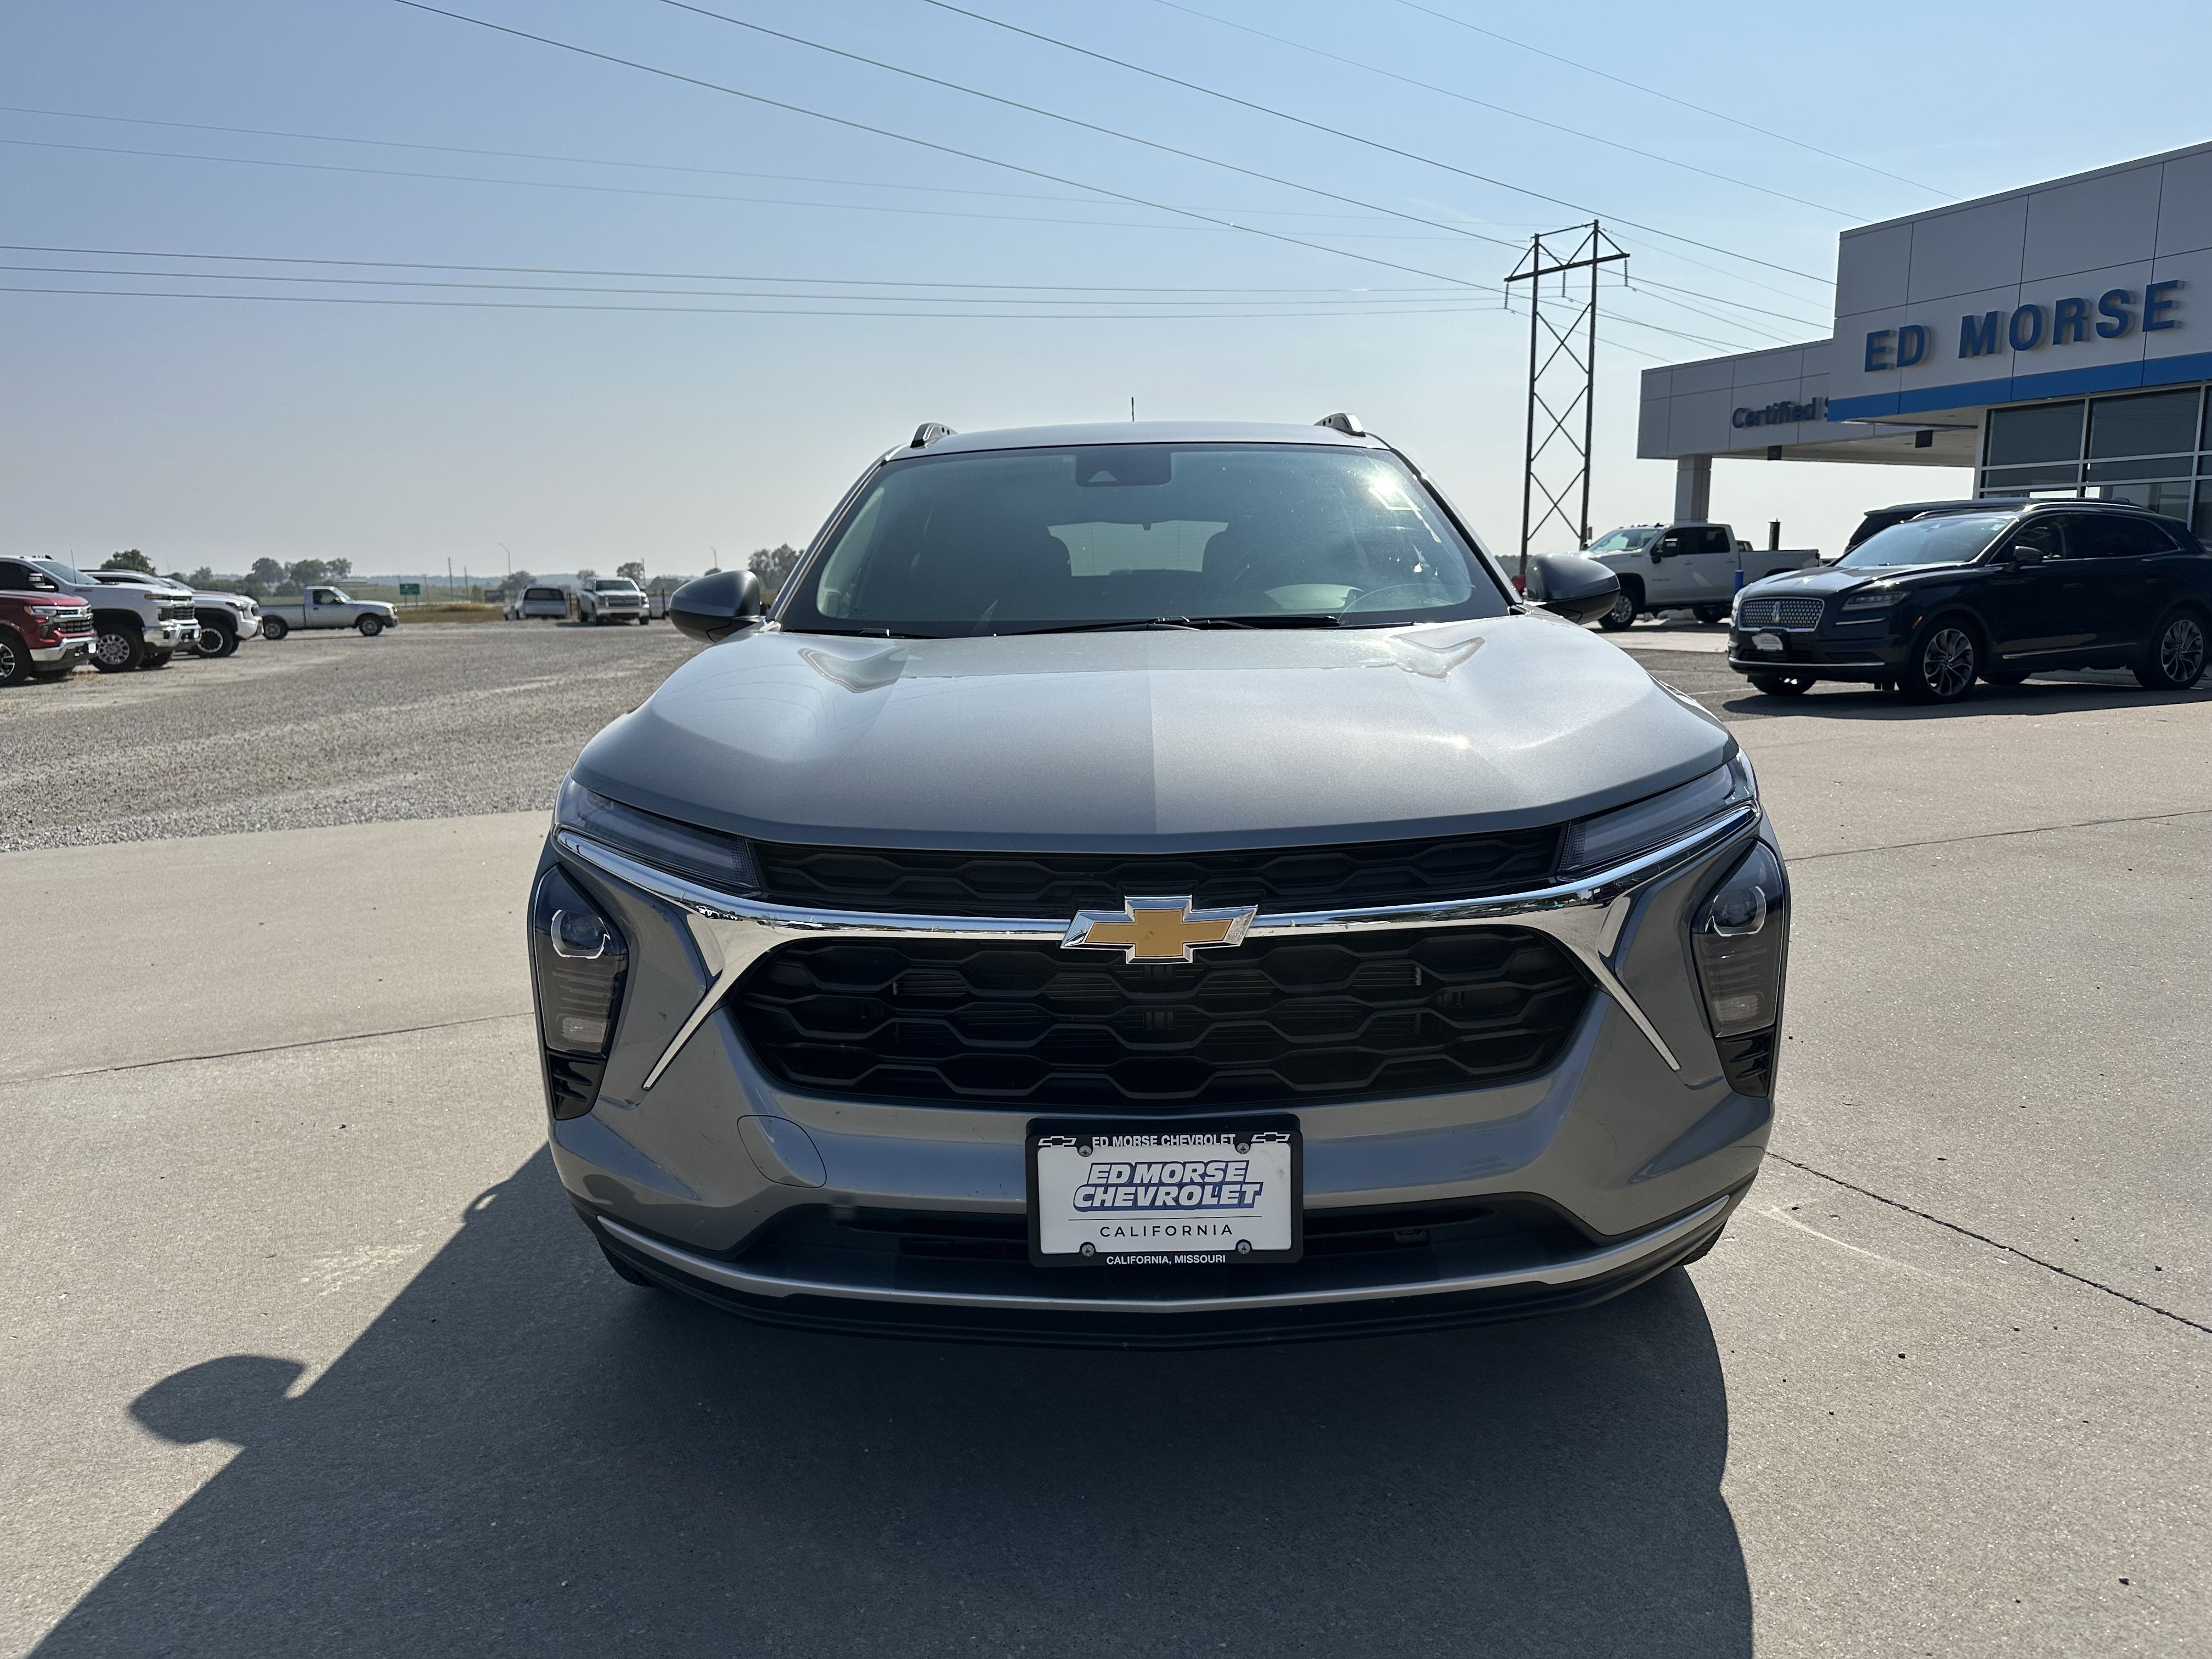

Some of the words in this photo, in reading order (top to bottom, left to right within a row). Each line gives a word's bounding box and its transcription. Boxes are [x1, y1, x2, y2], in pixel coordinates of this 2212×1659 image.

[1865, 324, 1928, 373] ED
[1959, 280, 2183, 358] MORSE
[1732, 397, 1817, 428] Certified
[1092, 1136, 1109, 1148] ED
[1113, 1135, 1158, 1147] MORSE
[1161, 1134, 1235, 1147] CHEVROLET
[1087, 1163, 1132, 1184] ED
[1133, 1160, 1249, 1184] MORSE
[1074, 1182, 1263, 1211] CHEVROLET
[1099, 1224, 1233, 1237] CALIFORNIA
[1106, 1255, 1172, 1265] CALIFORNIA,
[1175, 1254, 1226, 1263] MISSOURI
